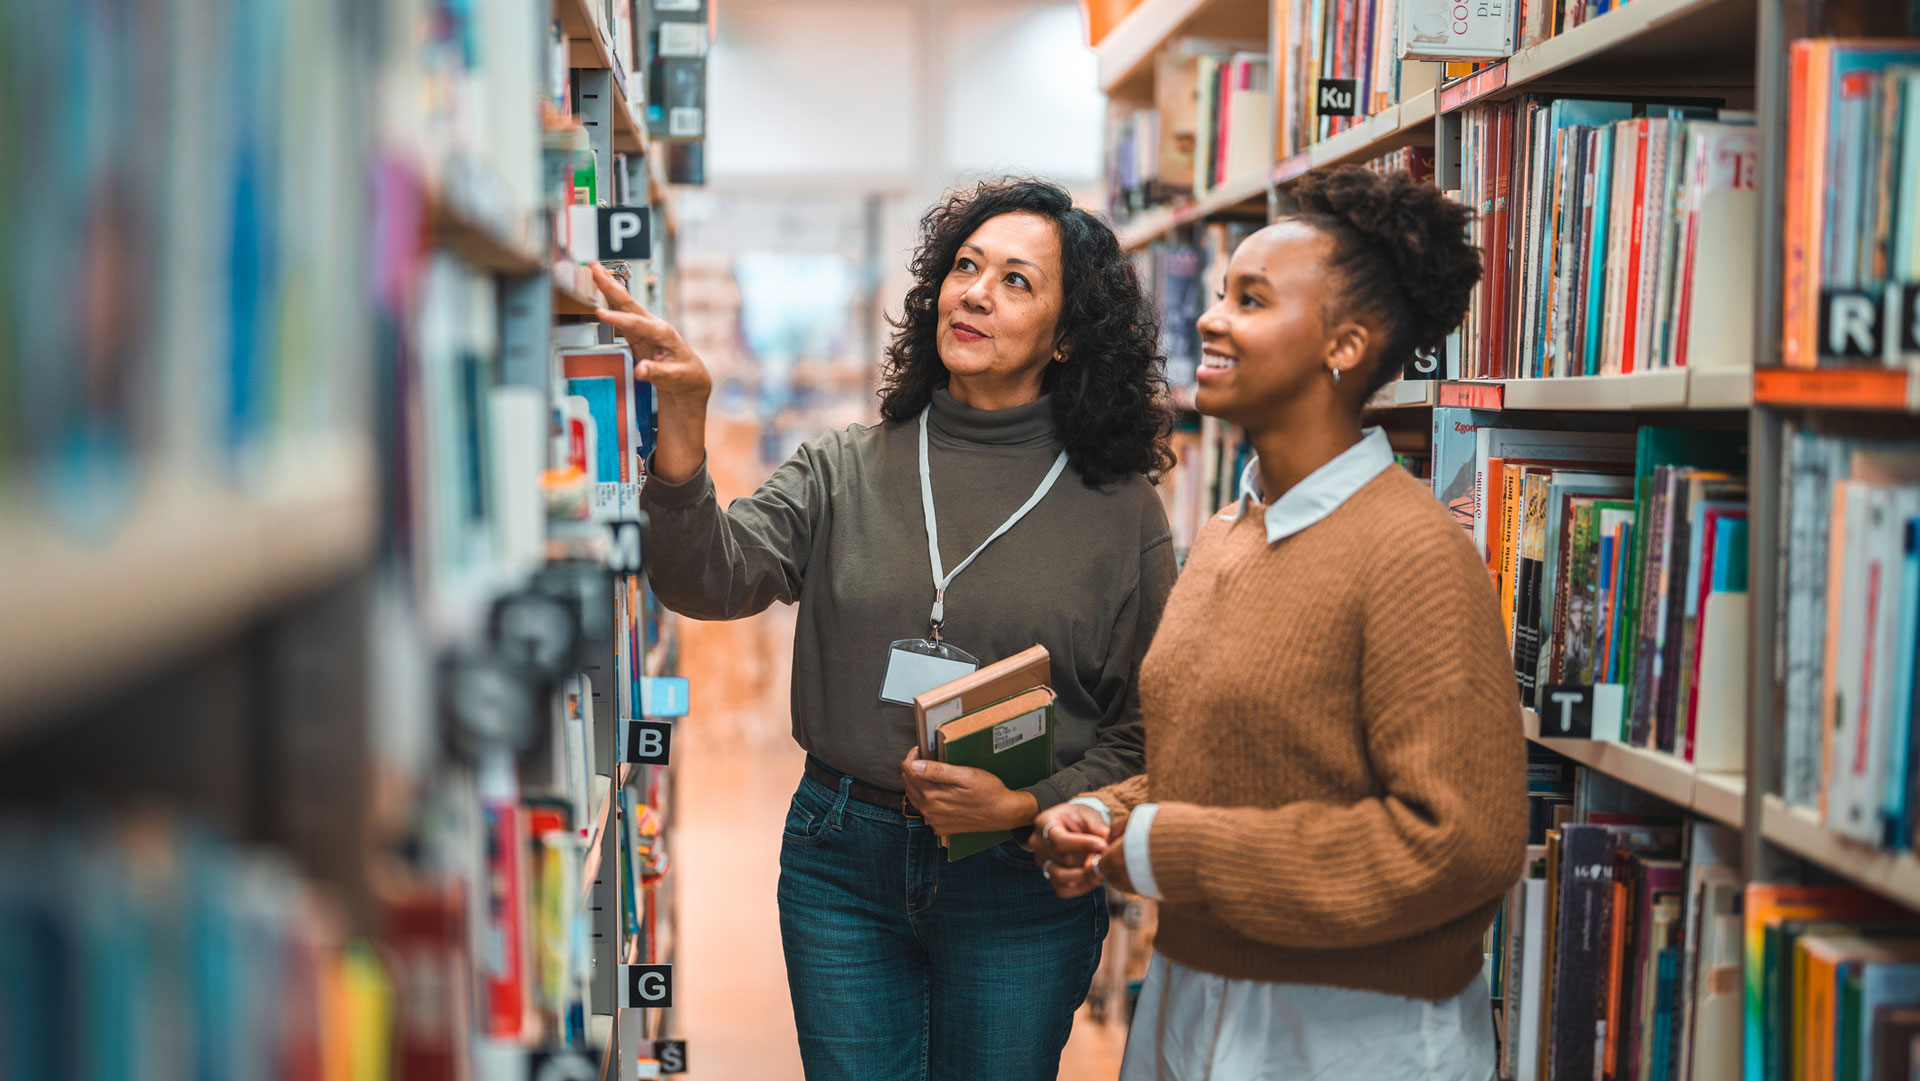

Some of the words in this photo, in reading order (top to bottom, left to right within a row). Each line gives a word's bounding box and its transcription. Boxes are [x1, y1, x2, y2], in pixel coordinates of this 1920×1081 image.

[1321, 86, 1352, 109] Ku
[610, 212, 642, 253] P
[1829, 295, 1876, 355] R
[1551, 691, 1584, 732] T
[638, 728, 663, 758] B
[638, 971, 667, 1001] G
[660, 1042, 684, 1072] Š
